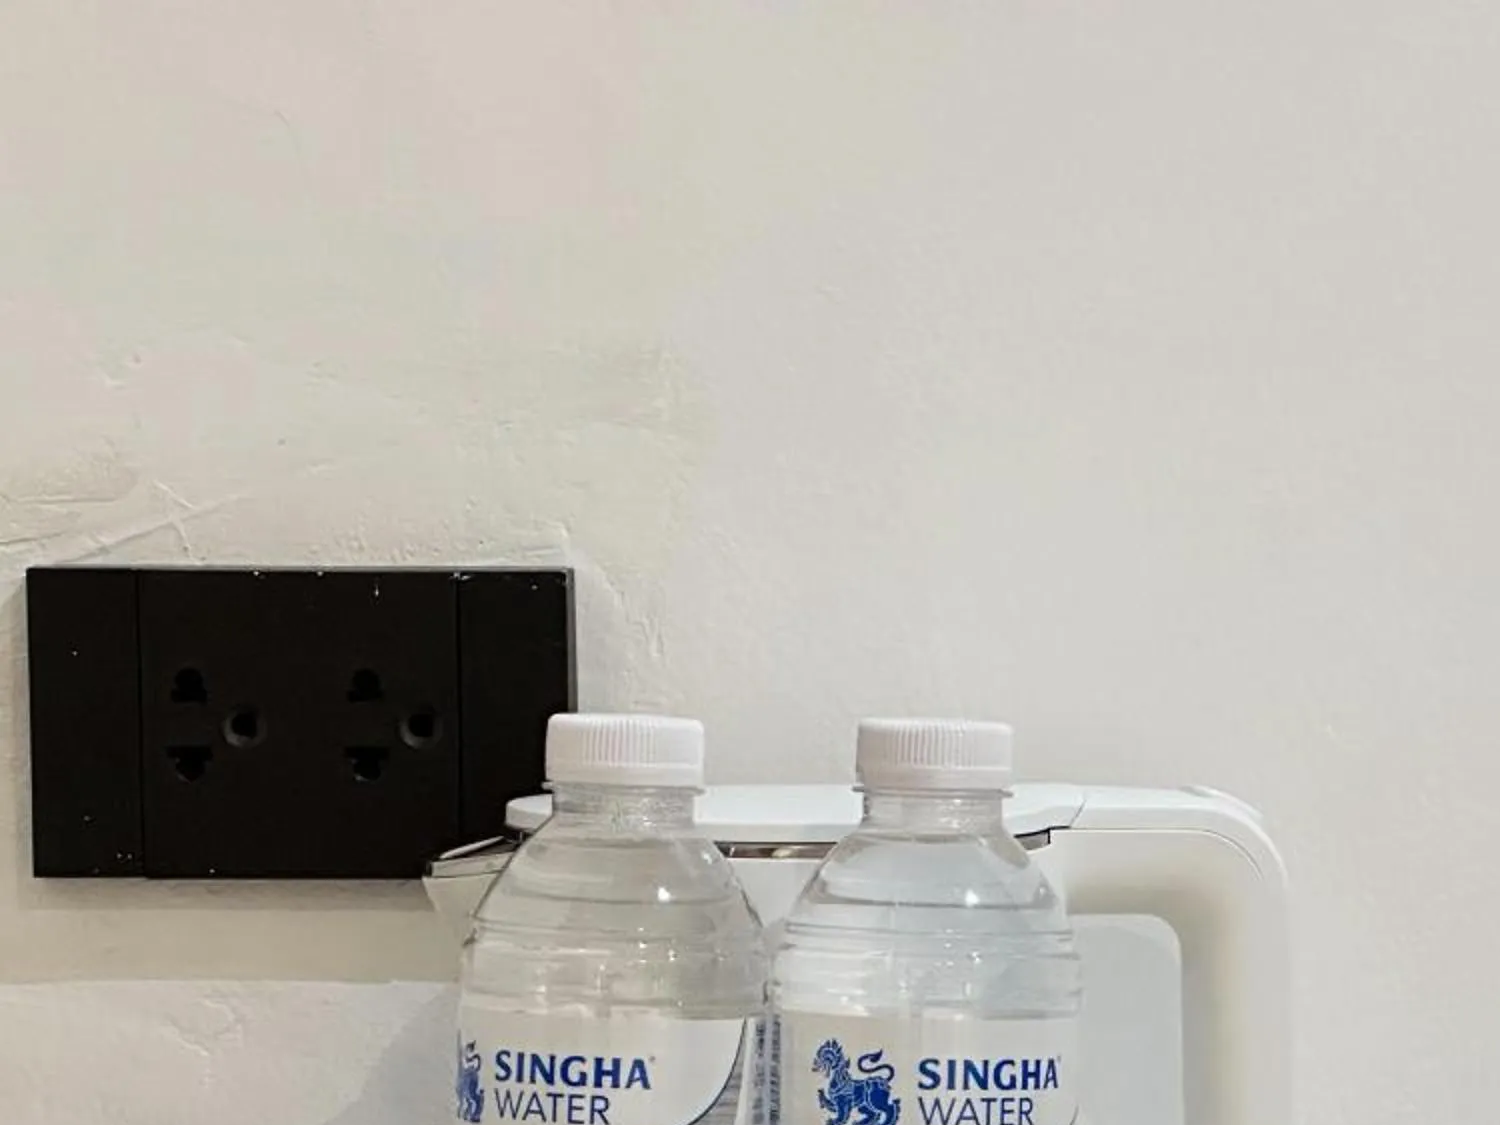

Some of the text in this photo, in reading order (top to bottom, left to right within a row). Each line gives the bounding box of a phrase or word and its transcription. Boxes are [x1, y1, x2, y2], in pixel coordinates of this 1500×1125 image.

[495, 1050, 652, 1090] SINGHA
[917, 1057, 1059, 1091] SINGHA
[495, 1088, 611, 1125] WATER
